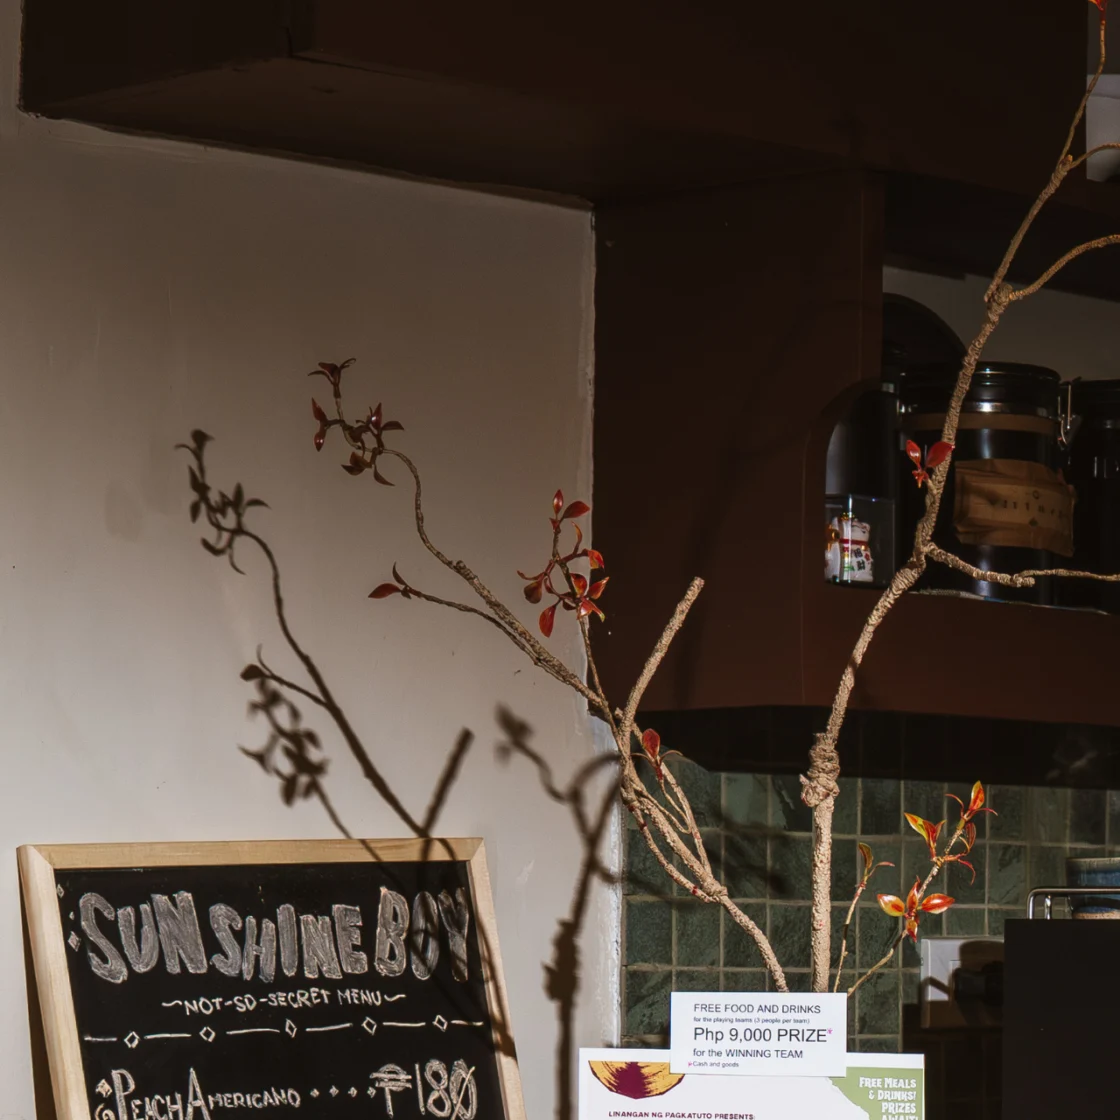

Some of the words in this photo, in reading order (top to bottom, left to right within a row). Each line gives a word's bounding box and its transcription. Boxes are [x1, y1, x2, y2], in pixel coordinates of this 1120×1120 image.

[375, 886, 469, 982] BOY
[337, 990, 382, 1006] MENU
[693, 1003, 721, 1013] FREE
[724, 1003, 754, 1014] FOOD
[757, 1004, 779, 1014] AND
[781, 1004, 821, 1014] DRINKS
[693, 1027, 724, 1044] Php
[729, 1028, 772, 1043] 9,000
[693, 1048, 705, 1057] for
[707, 1049, 723, 1057] the
[725, 1049, 772, 1058] WINNING
[774, 1050, 803, 1058] TEAM
[859, 1077, 882, 1088] FREE
[884, 1077, 917, 1088] MEALS
[881, 1102, 916, 1114] PRIZES
